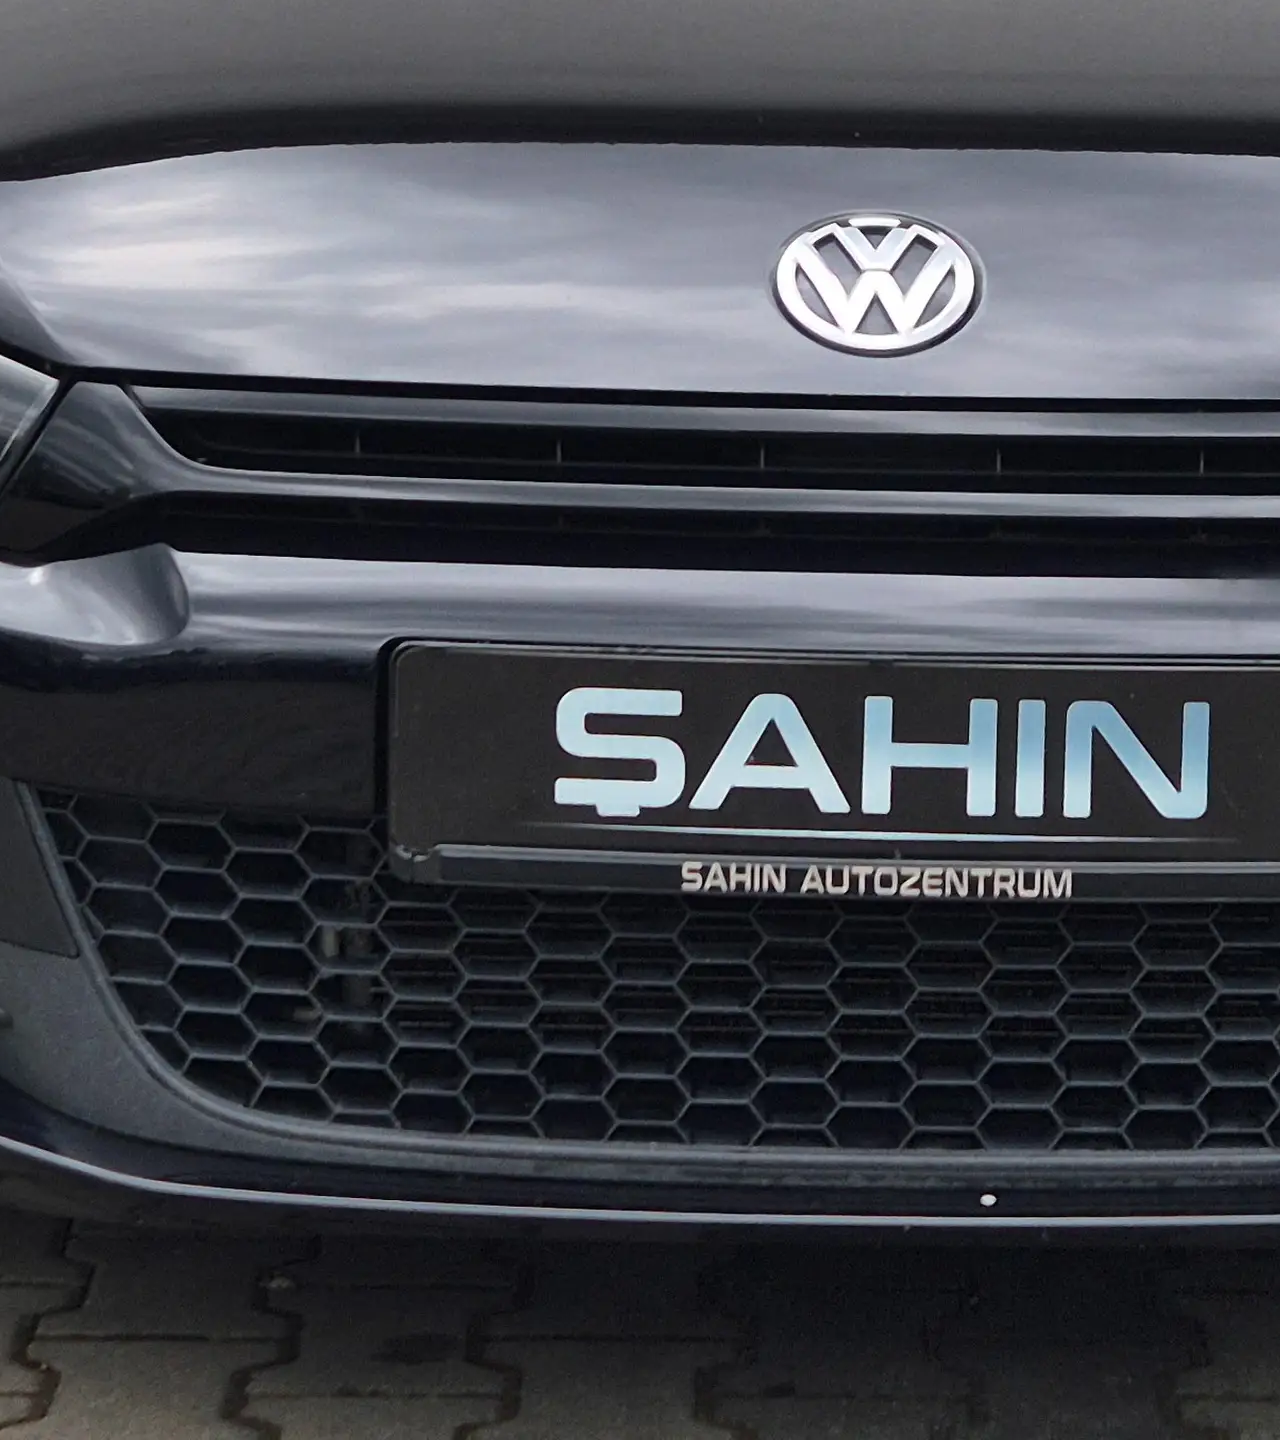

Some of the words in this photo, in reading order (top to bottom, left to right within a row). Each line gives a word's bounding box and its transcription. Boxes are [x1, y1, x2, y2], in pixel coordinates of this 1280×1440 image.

[780, 217, 972, 347] VW
[681, 860, 788, 893] SAHIN
[799, 863, 1073, 899] AUTOZENTRUM
